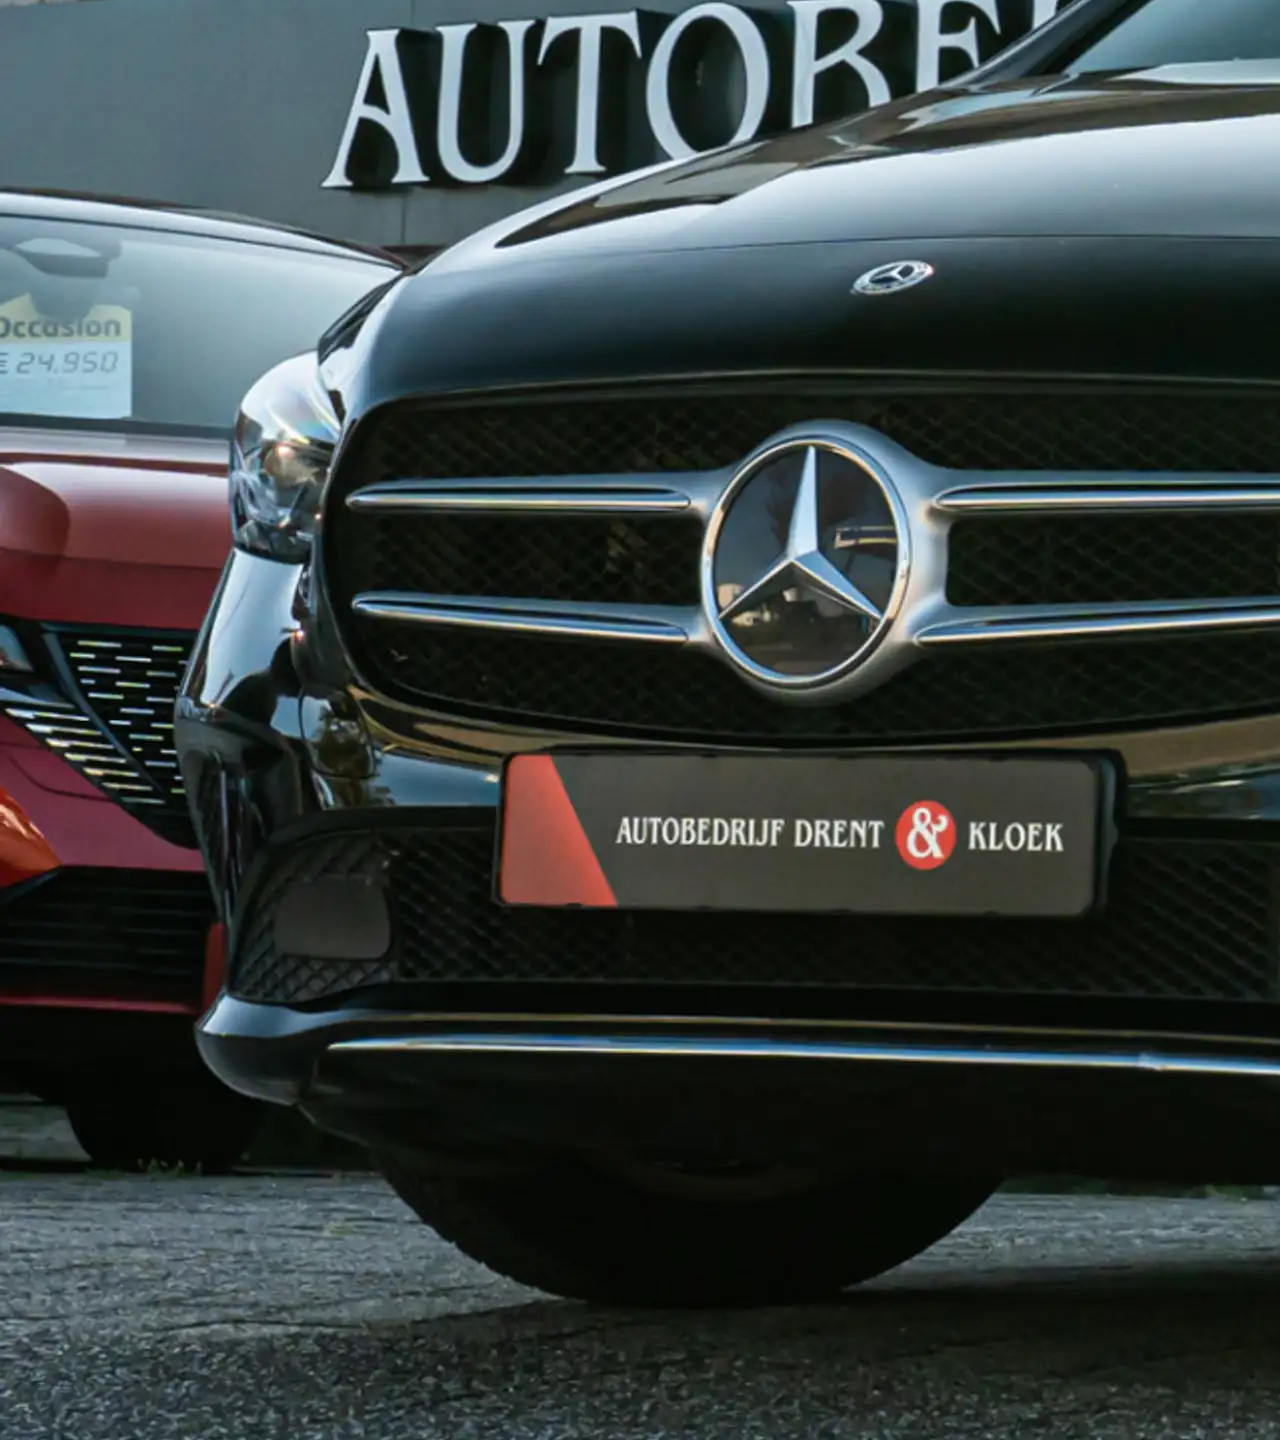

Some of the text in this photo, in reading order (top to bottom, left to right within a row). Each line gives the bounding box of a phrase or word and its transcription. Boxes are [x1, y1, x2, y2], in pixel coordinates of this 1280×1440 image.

[615, 807, 1064, 860] AUTOBEDRIJF DRENT & KLOEK
